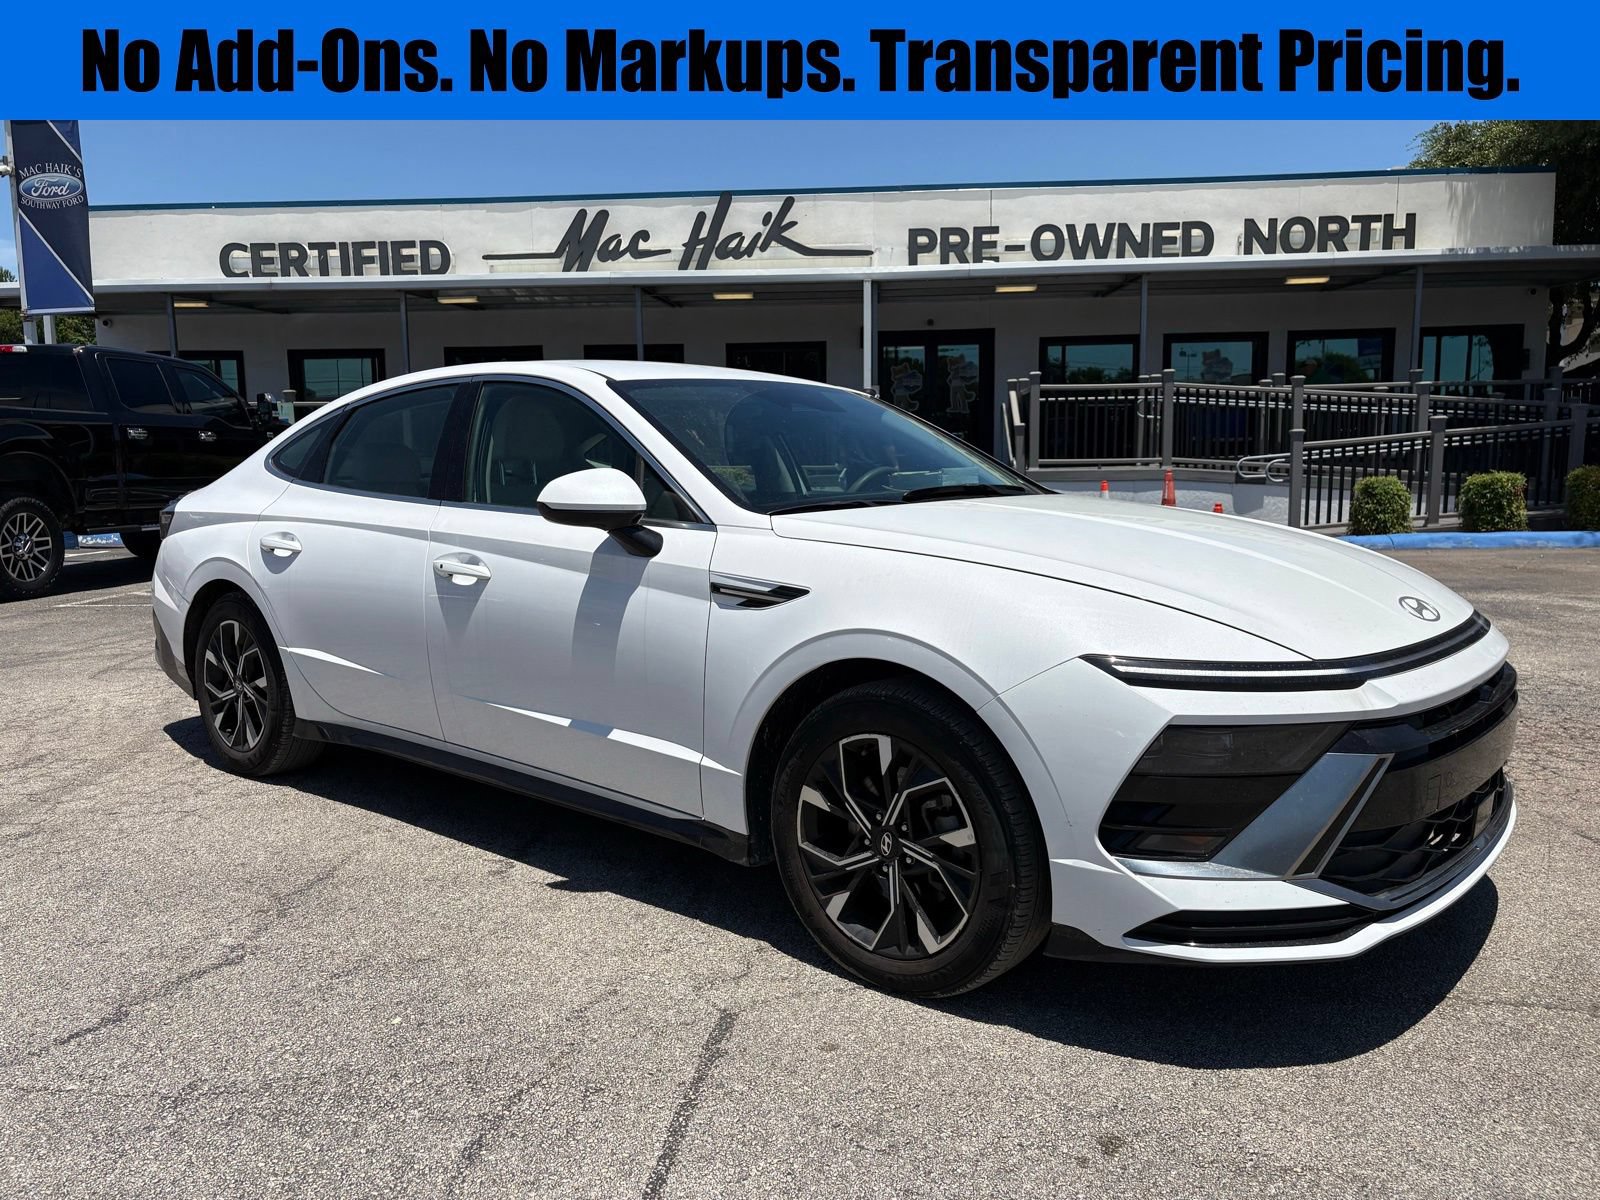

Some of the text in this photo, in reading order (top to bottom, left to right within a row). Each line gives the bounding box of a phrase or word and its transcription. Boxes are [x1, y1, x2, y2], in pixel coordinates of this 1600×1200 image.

[19, 163, 82, 179] MAC HAIK'S
[31, 177, 70, 196] Ford
[21, 195, 84, 209] SOUTHWAY FORD
[482, 191, 874, 272] Mac Haik
[908, 213, 1416, 265] PRE-OWNED NORTH
[219, 240, 451, 277] CERTIFIED
